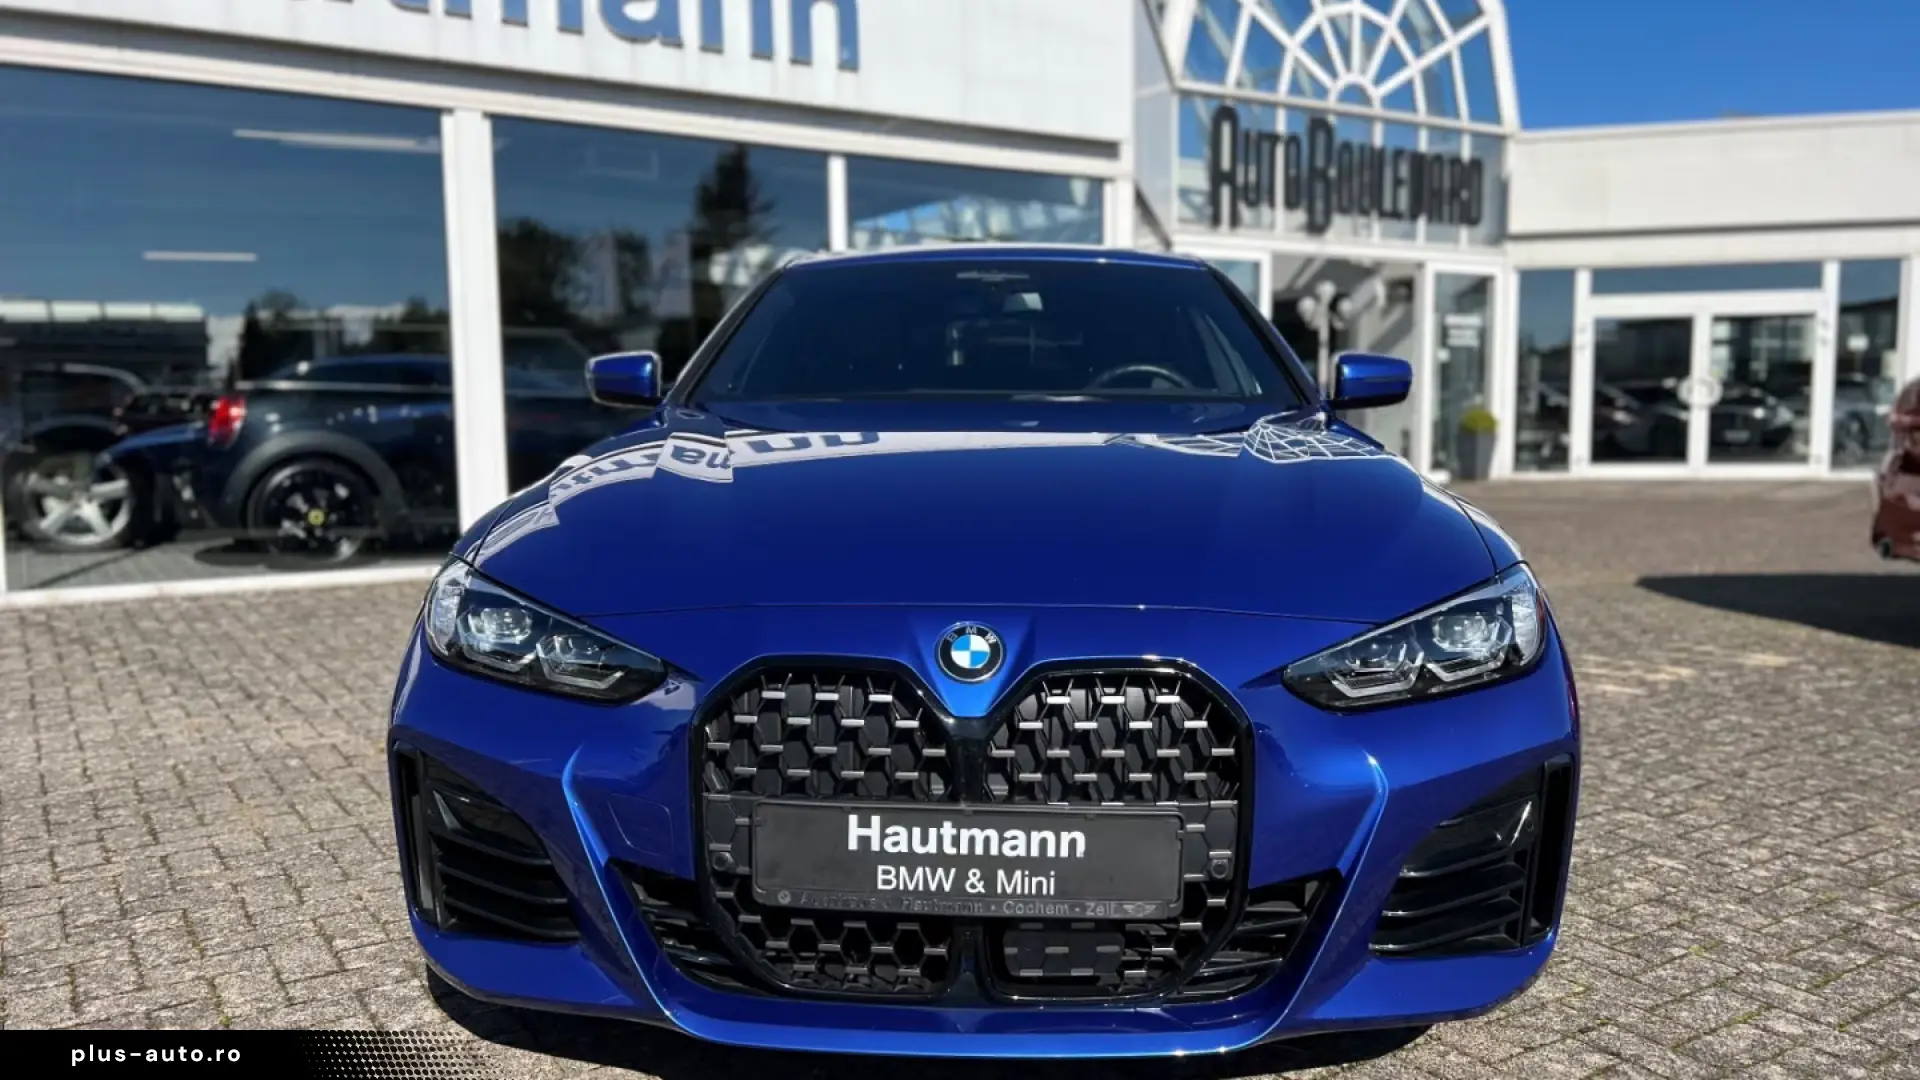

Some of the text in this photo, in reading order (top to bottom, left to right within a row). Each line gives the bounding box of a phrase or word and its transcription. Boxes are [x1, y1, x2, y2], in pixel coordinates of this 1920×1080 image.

[847, 814, 1086, 858] Hautmann
[876, 865, 1056, 896] BMW & Mini
[1003, 900, 1070, 916] Cochem
